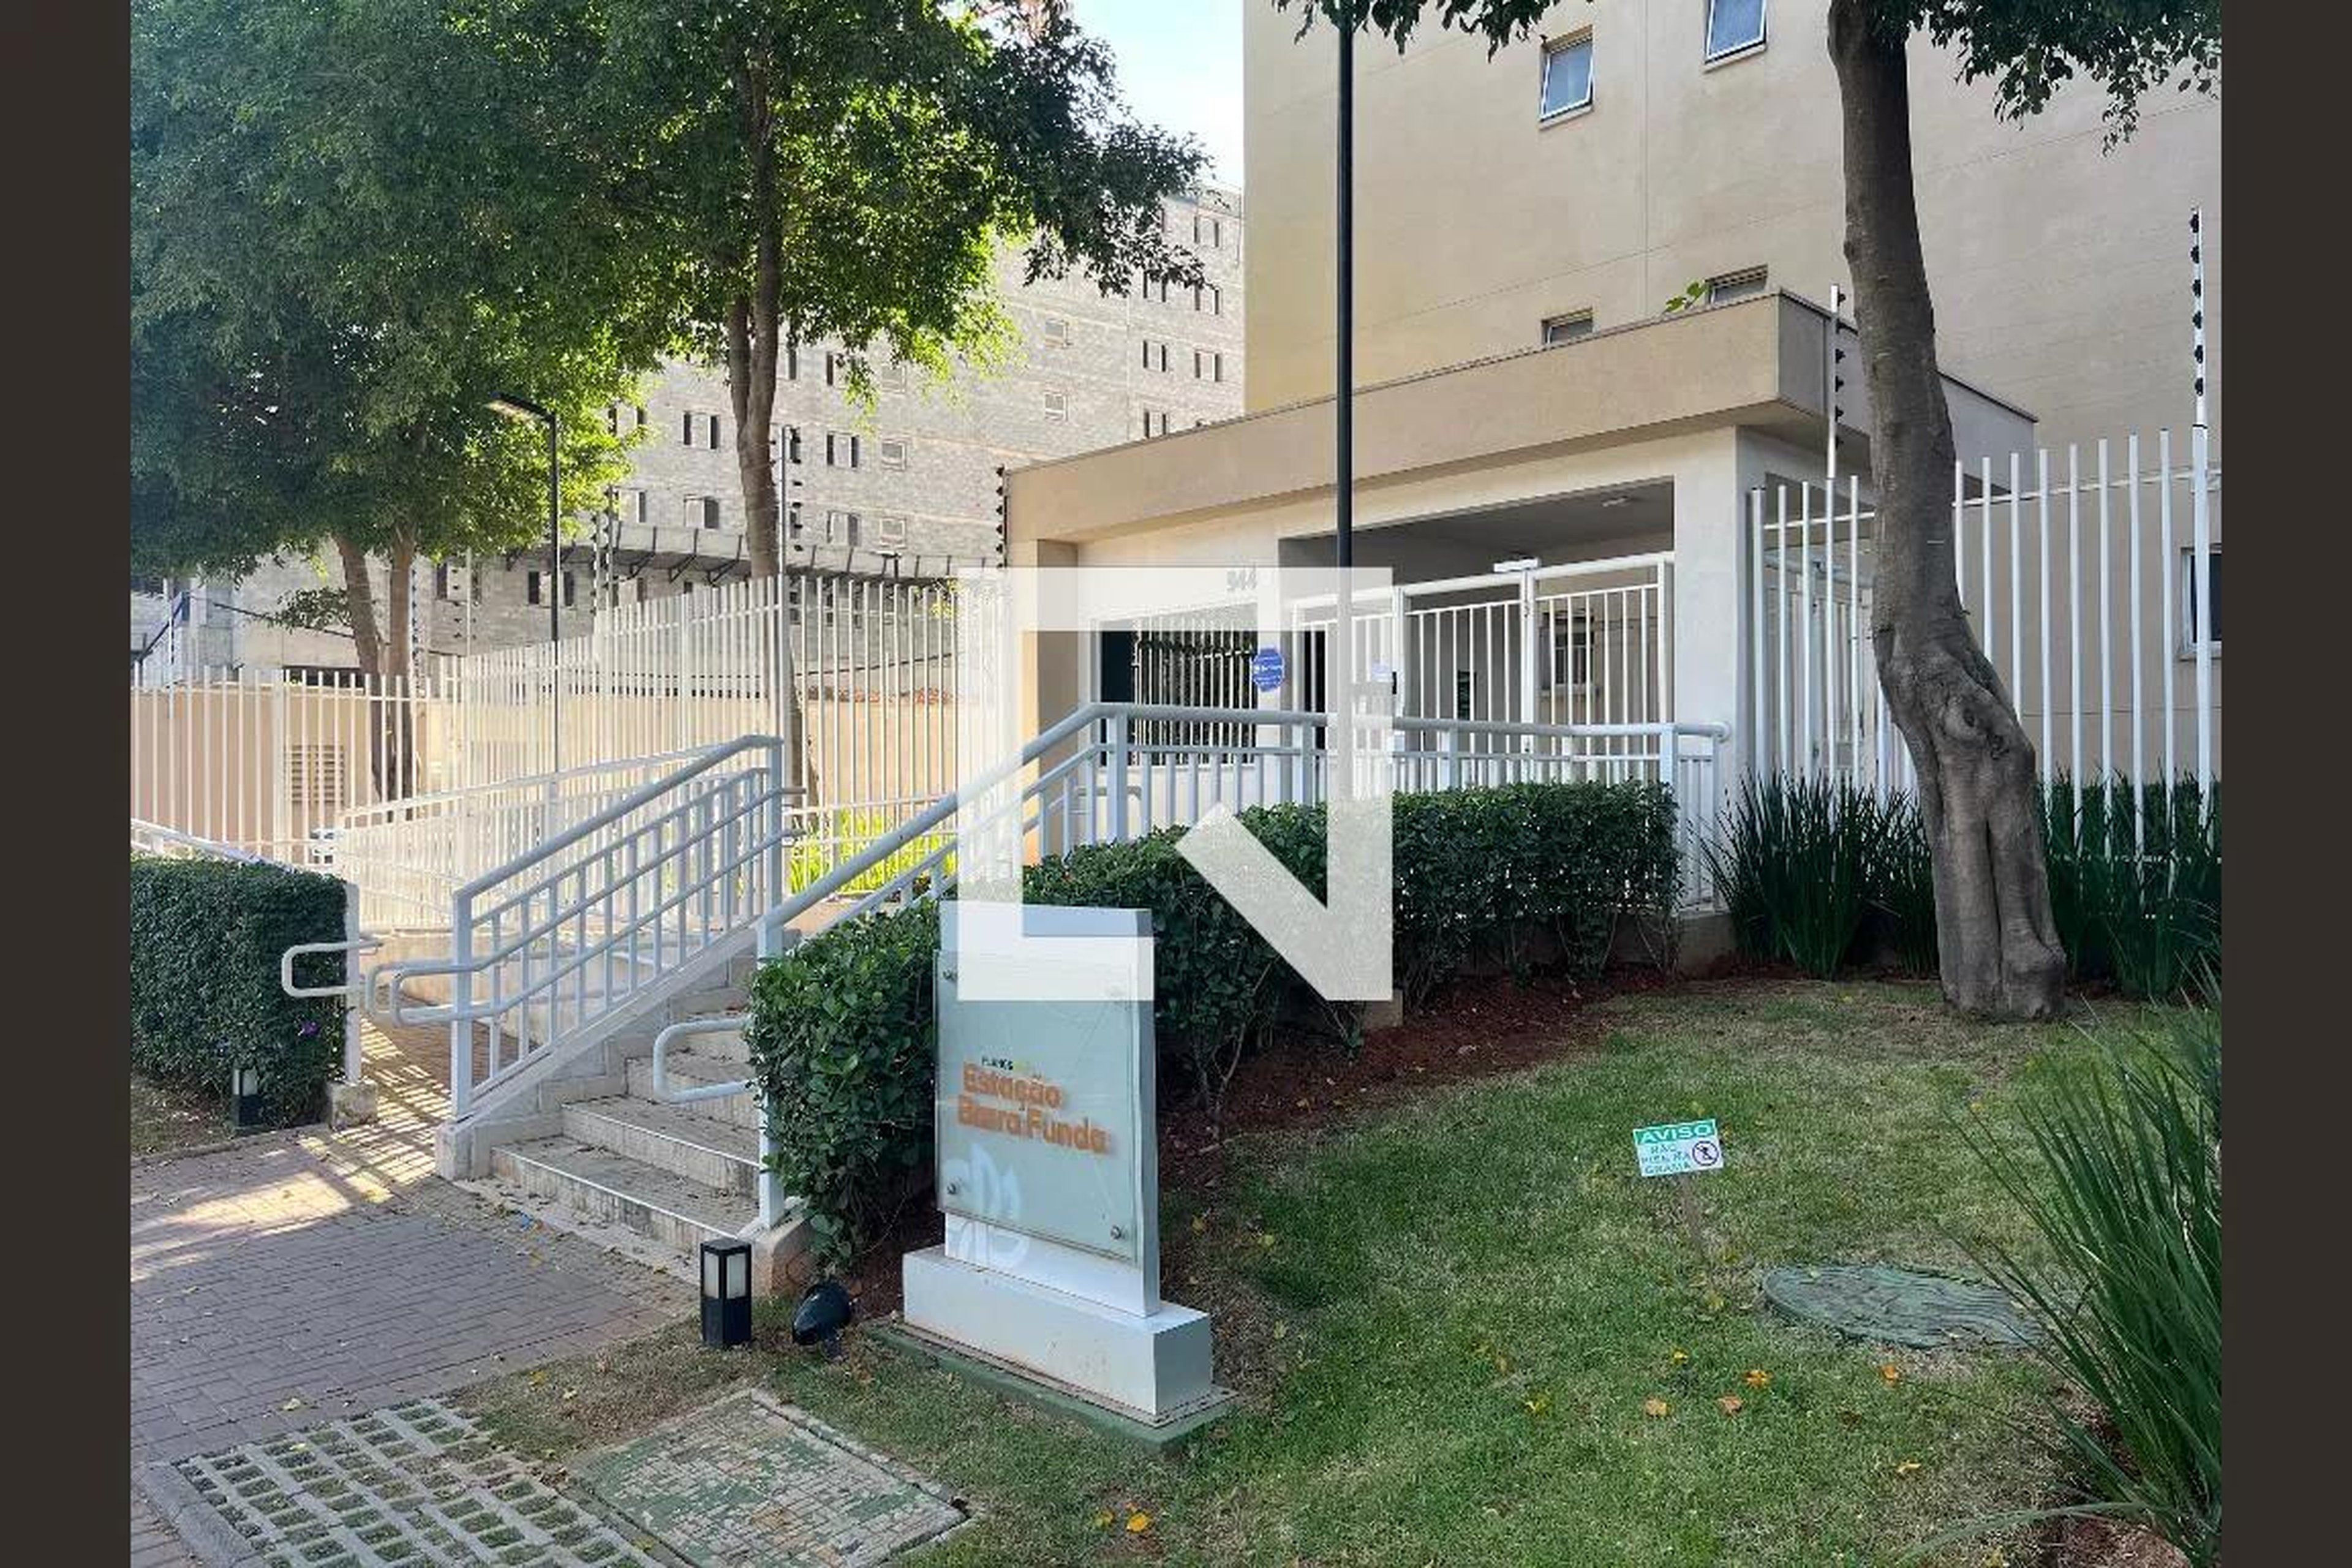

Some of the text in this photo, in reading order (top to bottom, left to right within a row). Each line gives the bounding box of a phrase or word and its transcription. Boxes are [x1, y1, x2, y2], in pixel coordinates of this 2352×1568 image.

[963, 1063, 1062, 1109] Estação
[1027, 1109, 1111, 1152] Funda
[1642, 1125, 1711, 1143] AVISO
